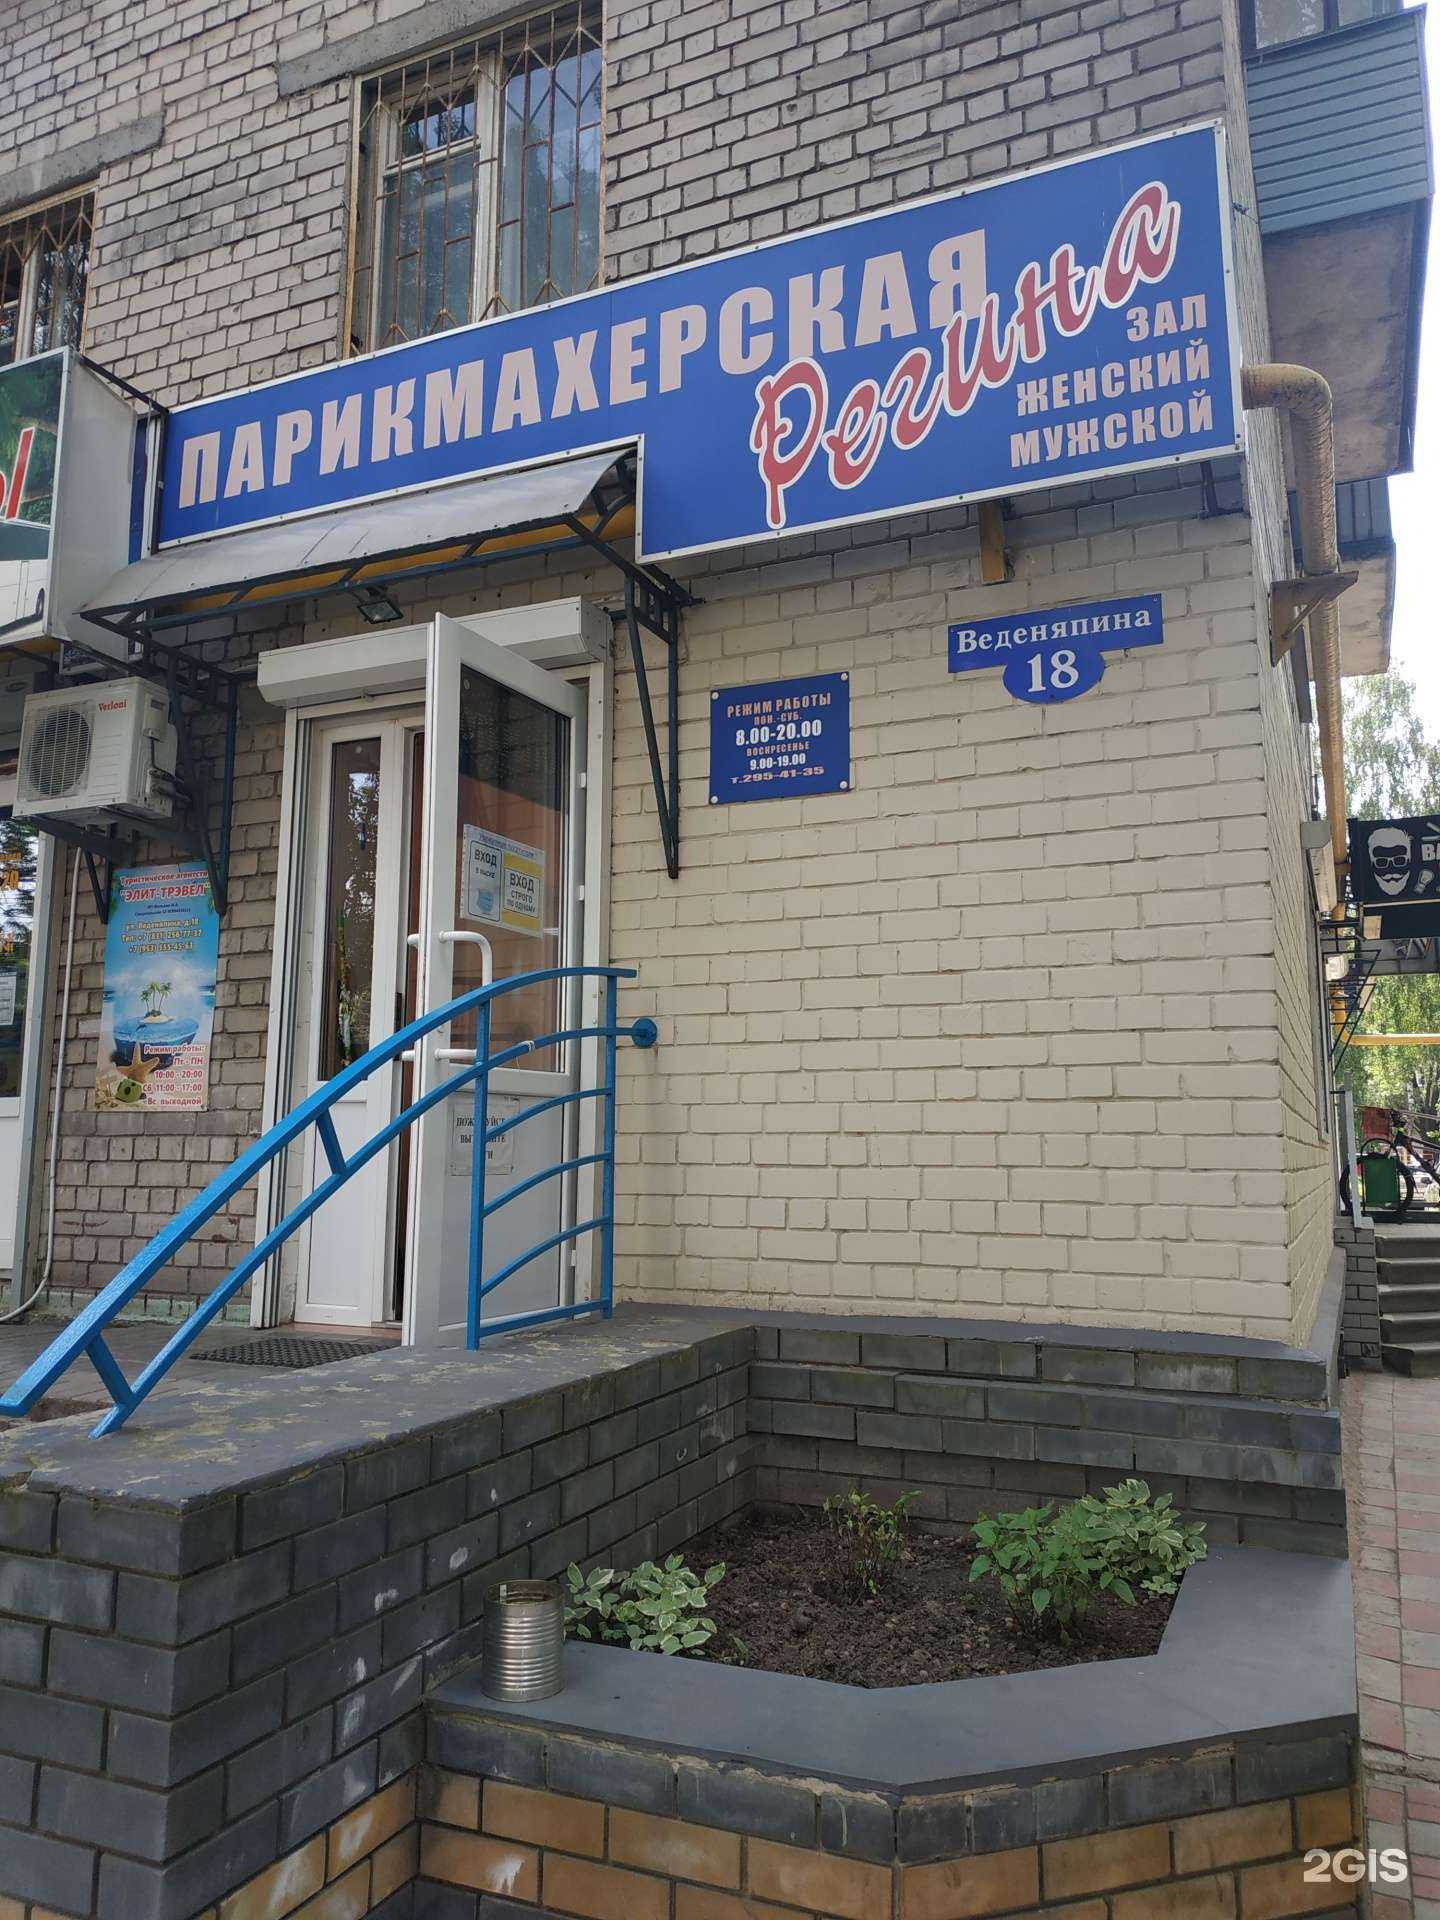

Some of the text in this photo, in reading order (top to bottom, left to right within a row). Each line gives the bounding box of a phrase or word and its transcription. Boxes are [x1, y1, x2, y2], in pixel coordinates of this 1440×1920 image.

[1126, 294, 1207, 342] ЗАЛ
[750, 181, 1182, 529] Регина
[178, 228, 988, 509] ПАРИКМАХЕРСКАЯ
[1016, 338, 1211, 417] ЖЕНСКИЙ
[1010, 389, 1214, 468] МУЖСКОЙ
[957, 610, 1152, 654] Веденяпина
[1027, 650, 1079, 693] 18
[727, 692, 831, 718] РЕЖИМ РАБОТЫ
[735, 719, 822, 746] 8.00-20.00
[746, 741, 810, 757] ВОСКРЕСЕНЬЕ
[750, 753, 806, 771] 9.00-19.00
[474, 848, 498, 869] ВХОД
[510, 872, 534, 894] ВХОД
[144, 1045, 171, 1053] Режим
[155, 1070, 175, 1078] 10:00
[181, 1070, 203, 1078] 20:00
[156, 1083, 175, 1091] 11:00
[182, 1083, 202, 1091] 17:00
